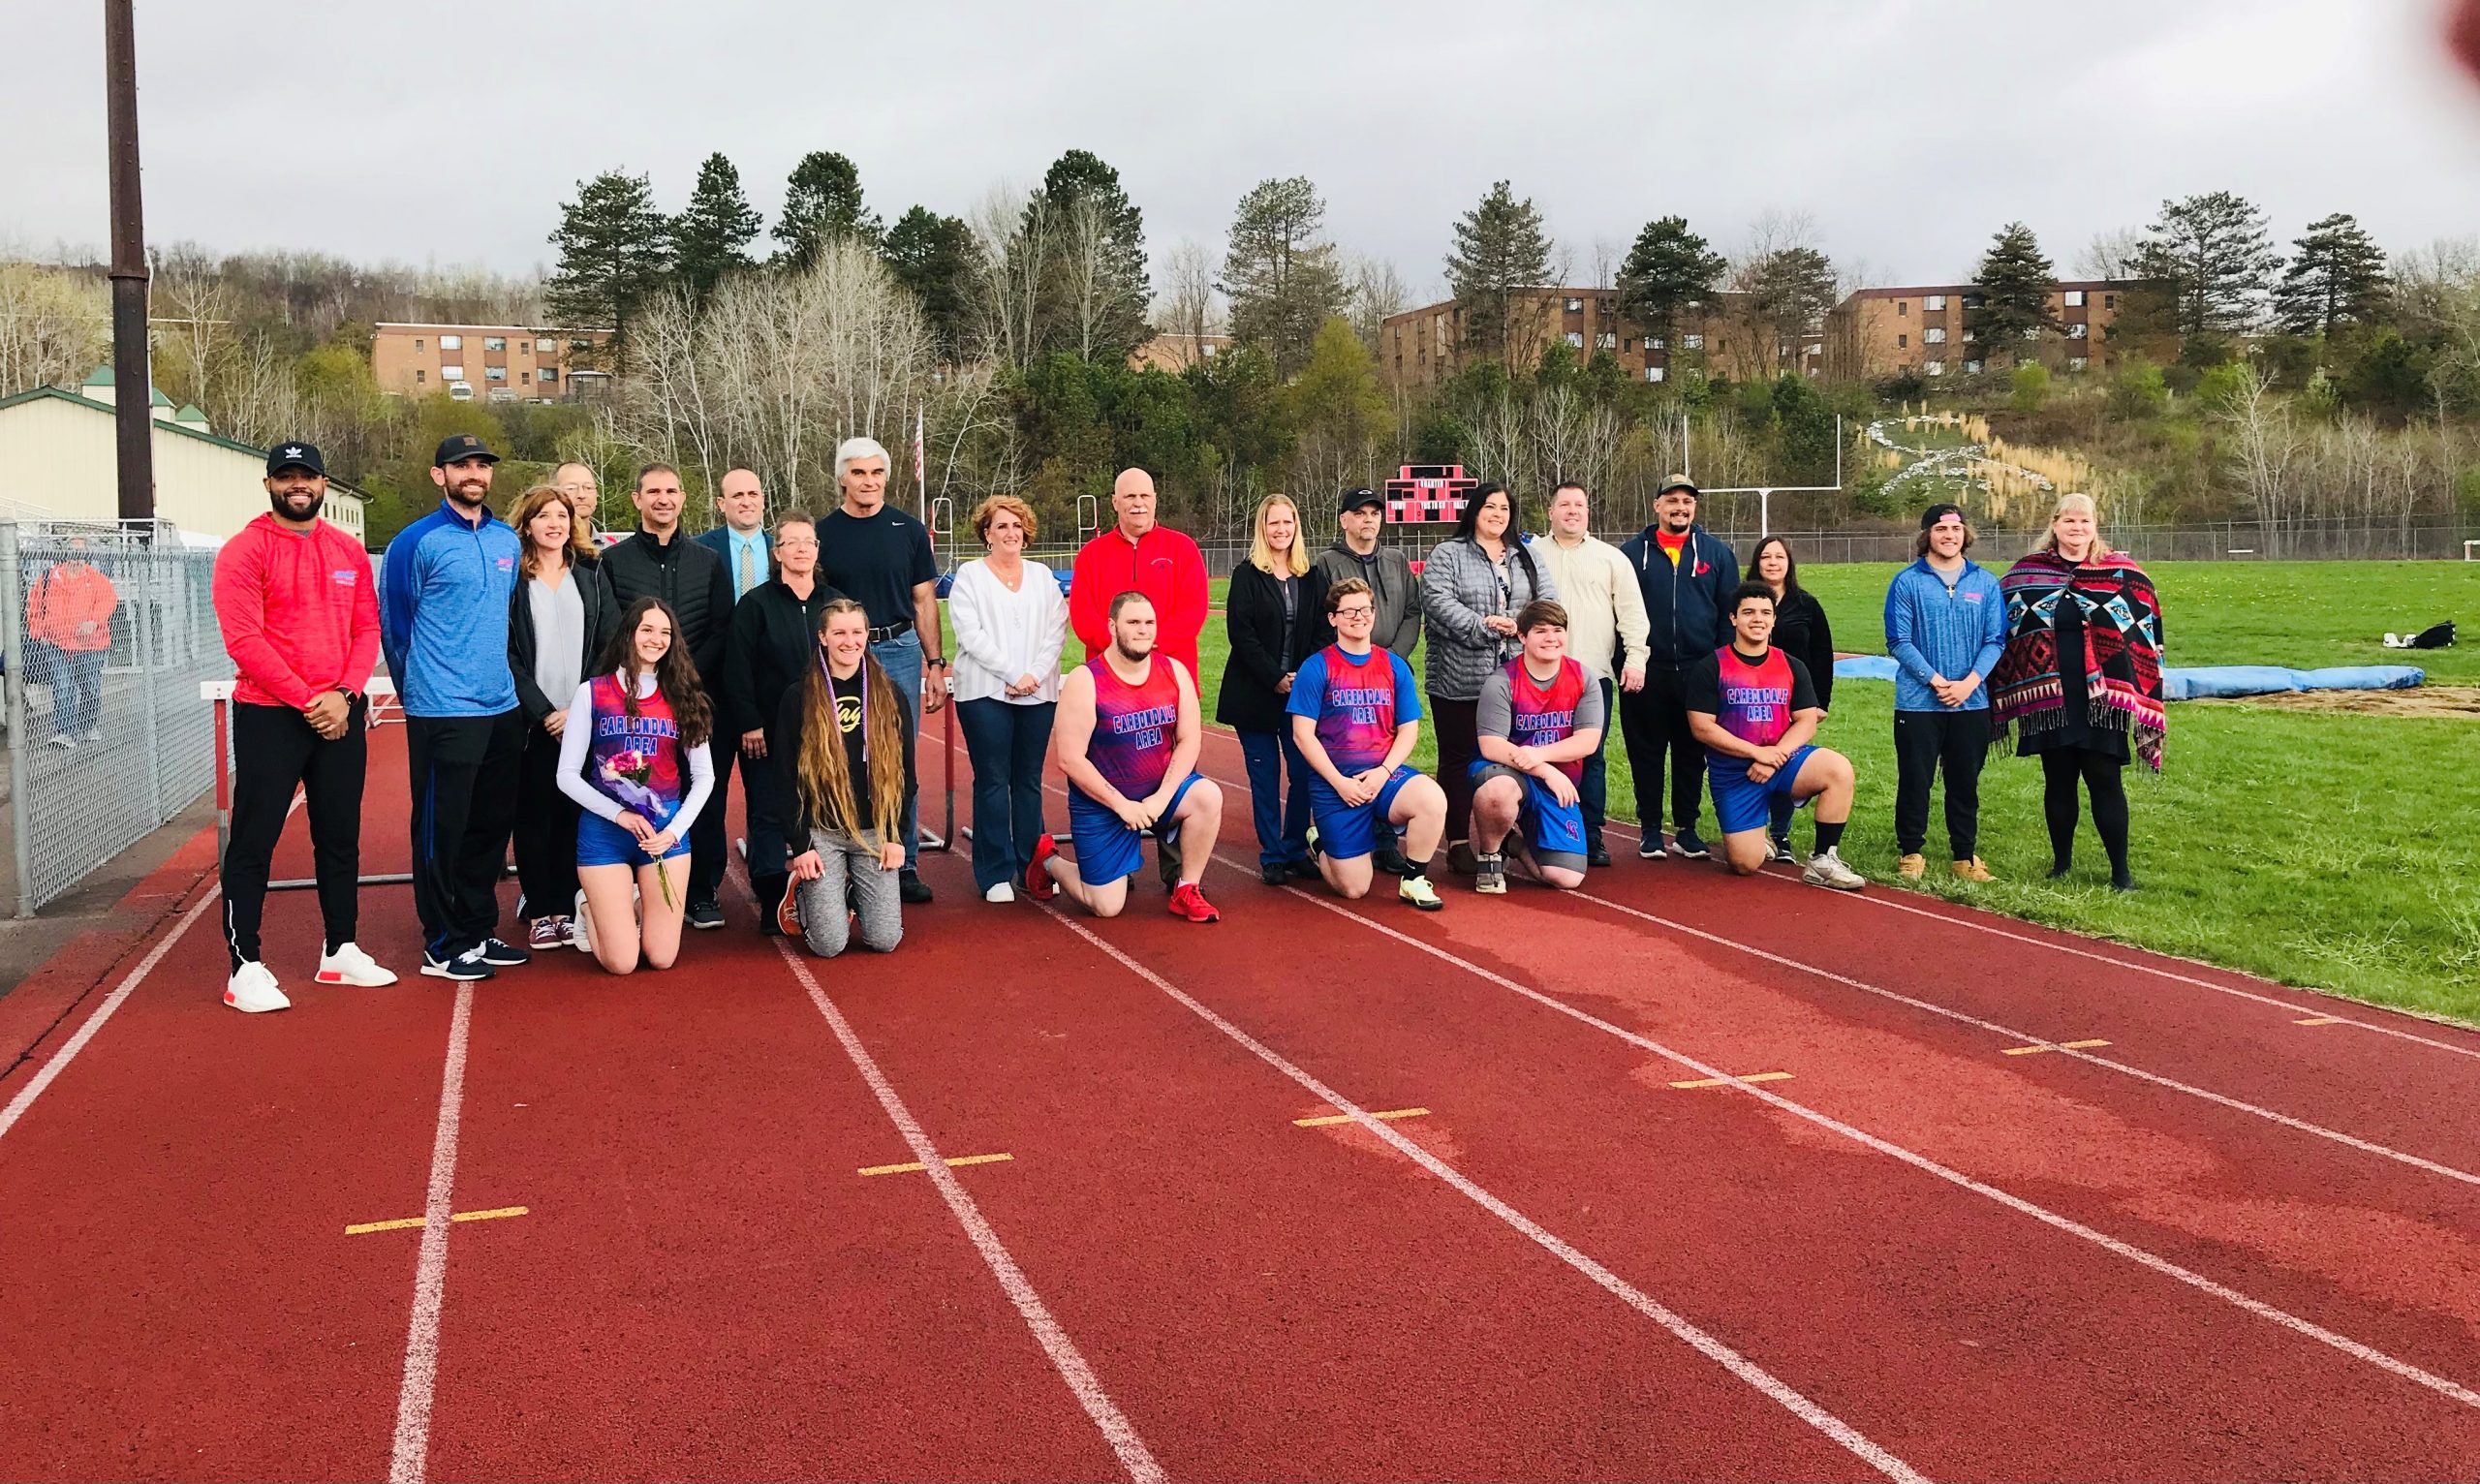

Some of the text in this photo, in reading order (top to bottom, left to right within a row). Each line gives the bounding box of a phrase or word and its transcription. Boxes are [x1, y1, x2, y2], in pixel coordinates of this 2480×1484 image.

[1331, 689, 1391, 707] CARBONDALE
[1727, 688, 1788, 704] CARBONDALE
[1113, 704, 1176, 734] CARBONDALE
[1351, 706, 1378, 725] AREA
[1516, 710, 1574, 730] CARBONDALE
[1747, 705, 1774, 722] AREA
[600, 715, 680, 739] CARONDALE
[623, 735, 658, 756] AREA
[1135, 727, 1162, 751] AREA
[1532, 729, 1561, 748] AREA
